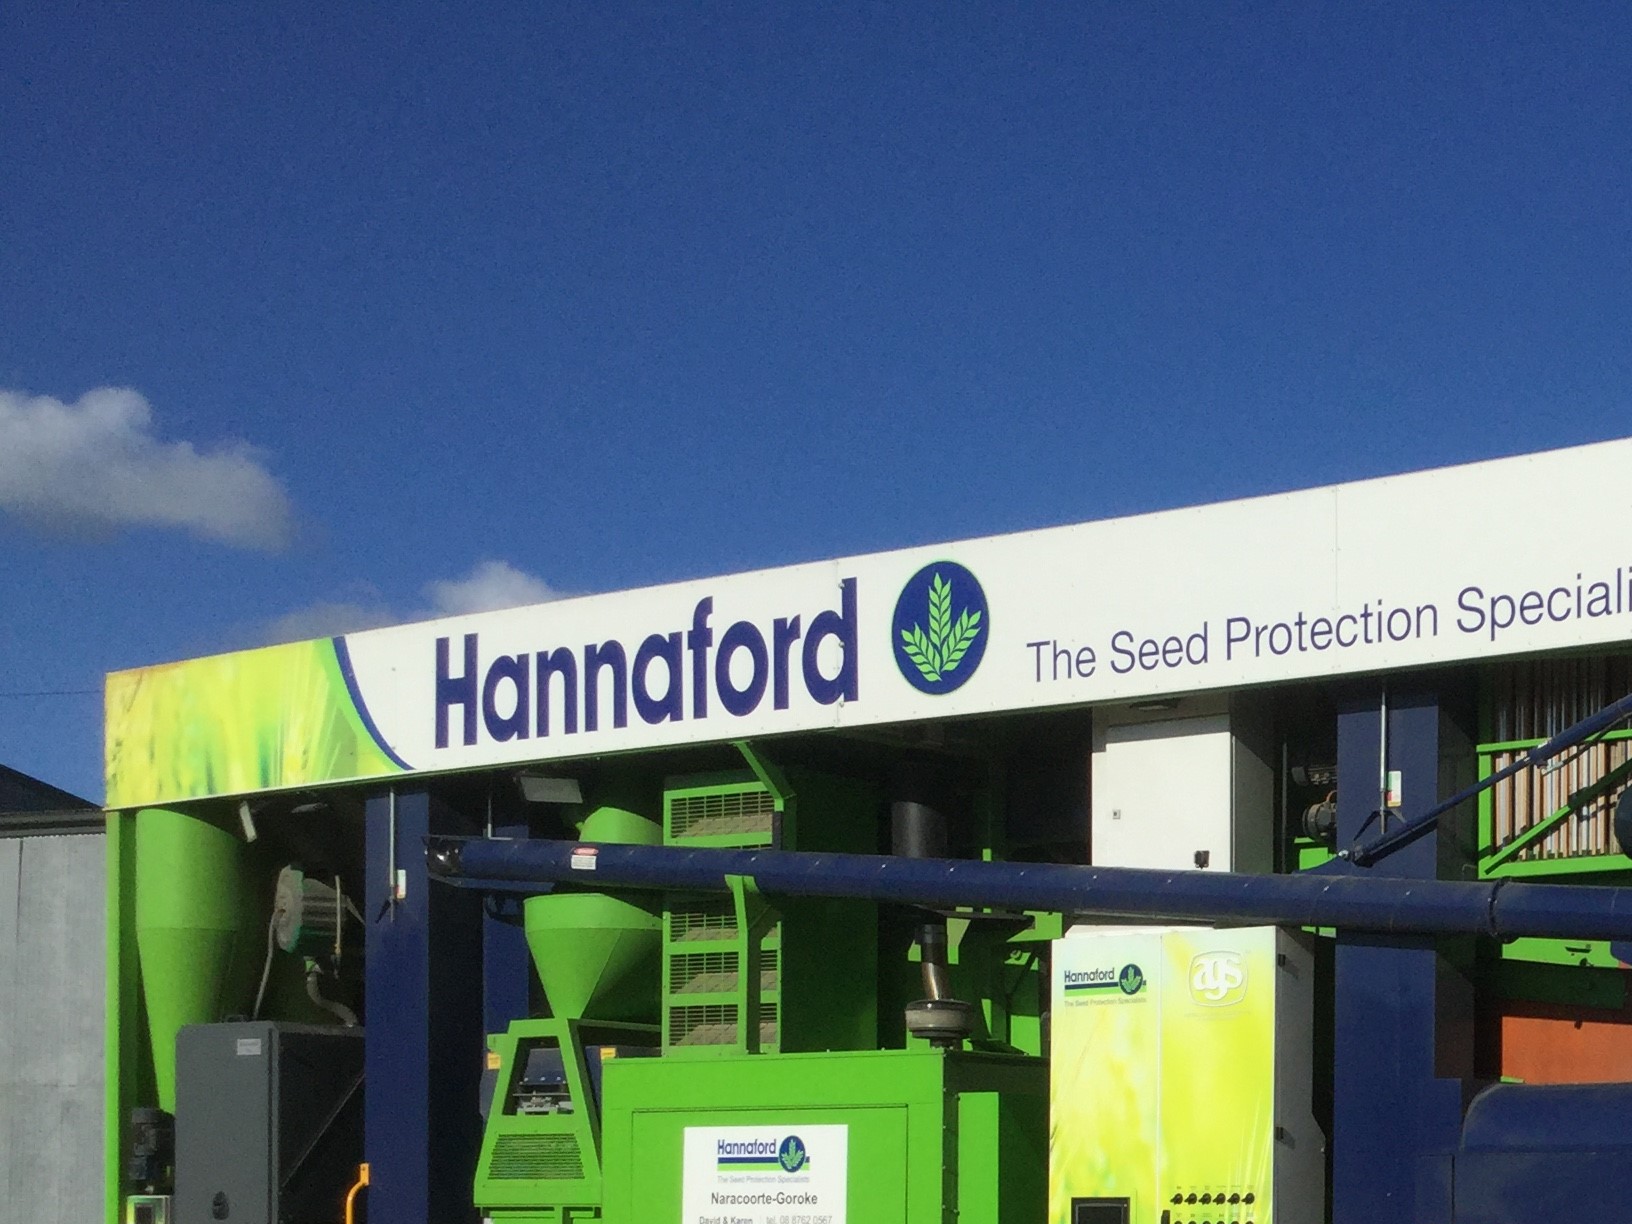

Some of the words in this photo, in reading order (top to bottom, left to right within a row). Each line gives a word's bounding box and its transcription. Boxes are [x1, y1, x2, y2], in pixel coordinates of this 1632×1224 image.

[1026, 640, 1097, 682] The
[1109, 621, 1209, 674] Seed
[1225, 597, 1439, 661] Protection
[435, 577, 859, 749] Hannaford
[1063, 967, 1115, 983] Hannaford
[717, 1138, 777, 1155] Hannaford
[711, 1191, 818, 1205] Naracoorte-Goroke
